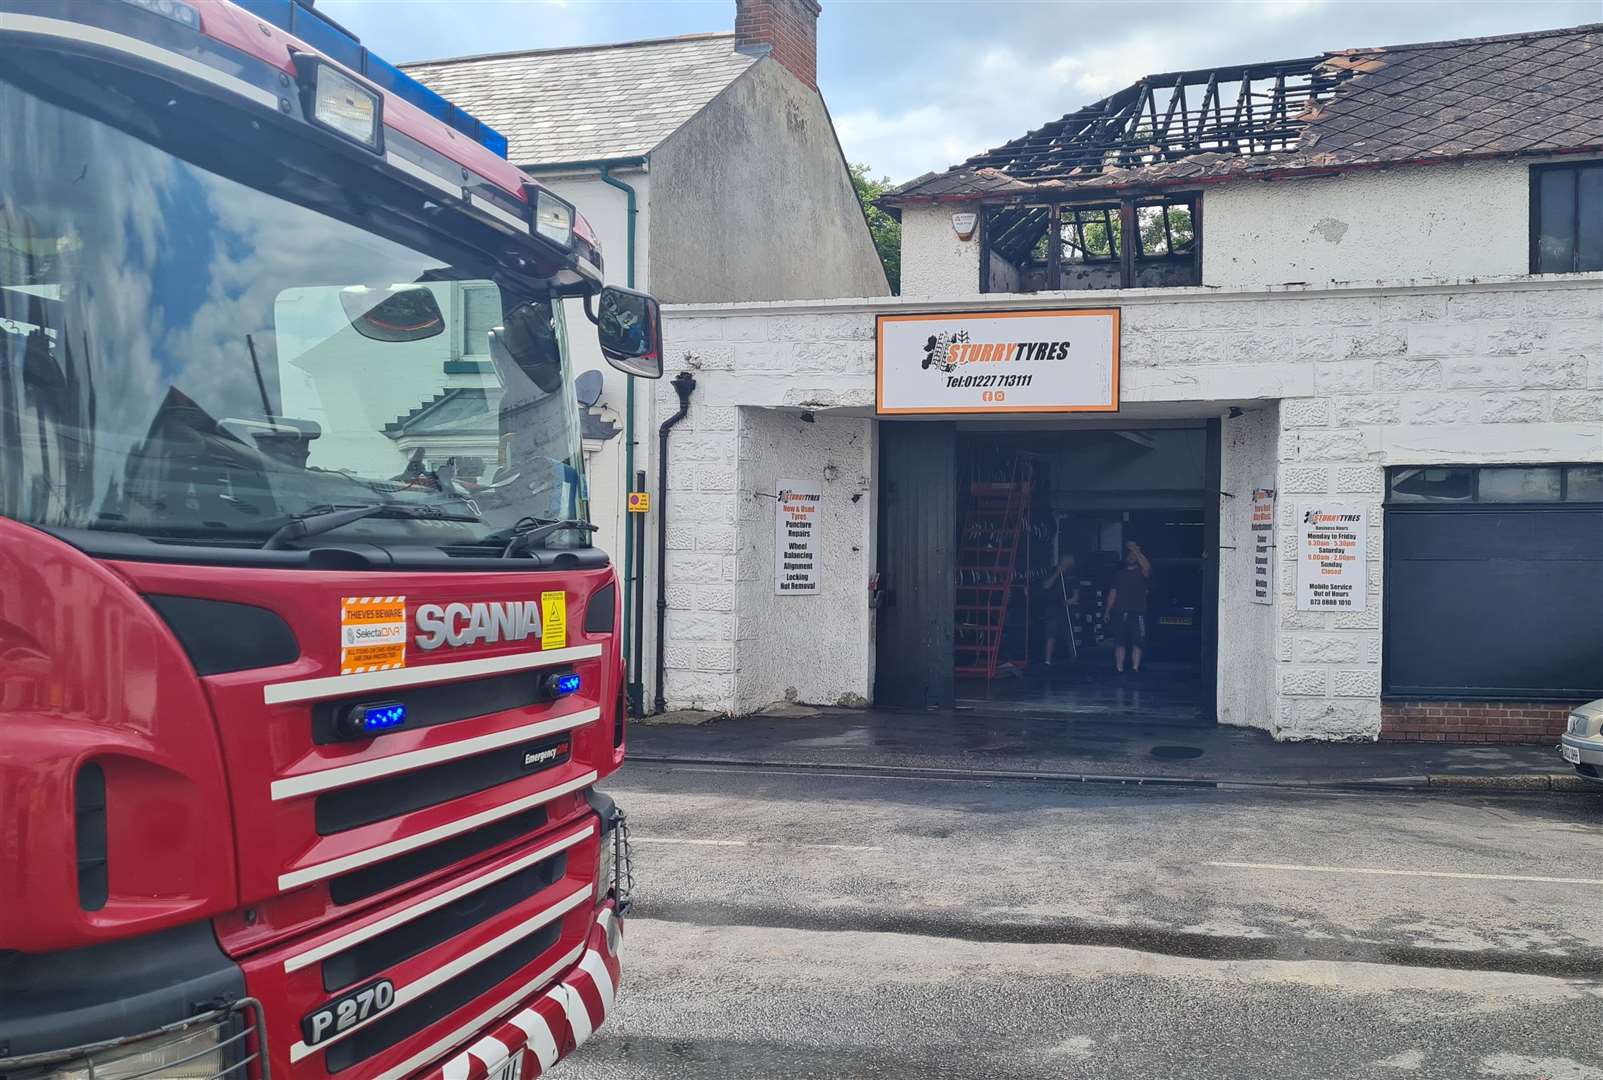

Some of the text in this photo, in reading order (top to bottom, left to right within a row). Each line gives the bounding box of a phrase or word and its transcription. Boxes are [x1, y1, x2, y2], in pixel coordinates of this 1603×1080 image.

[947, 341, 1070, 363] STURRYTYRES
[946, 374, 1032, 388] Tel:01227 713111
[784, 562, 812, 570] Alignment
[786, 573, 808, 581] Locking
[347, 608, 402, 619] THIEVES BEWARE
[415, 601, 541, 649] SCANIA
[312, 981, 393, 1044] P 270
